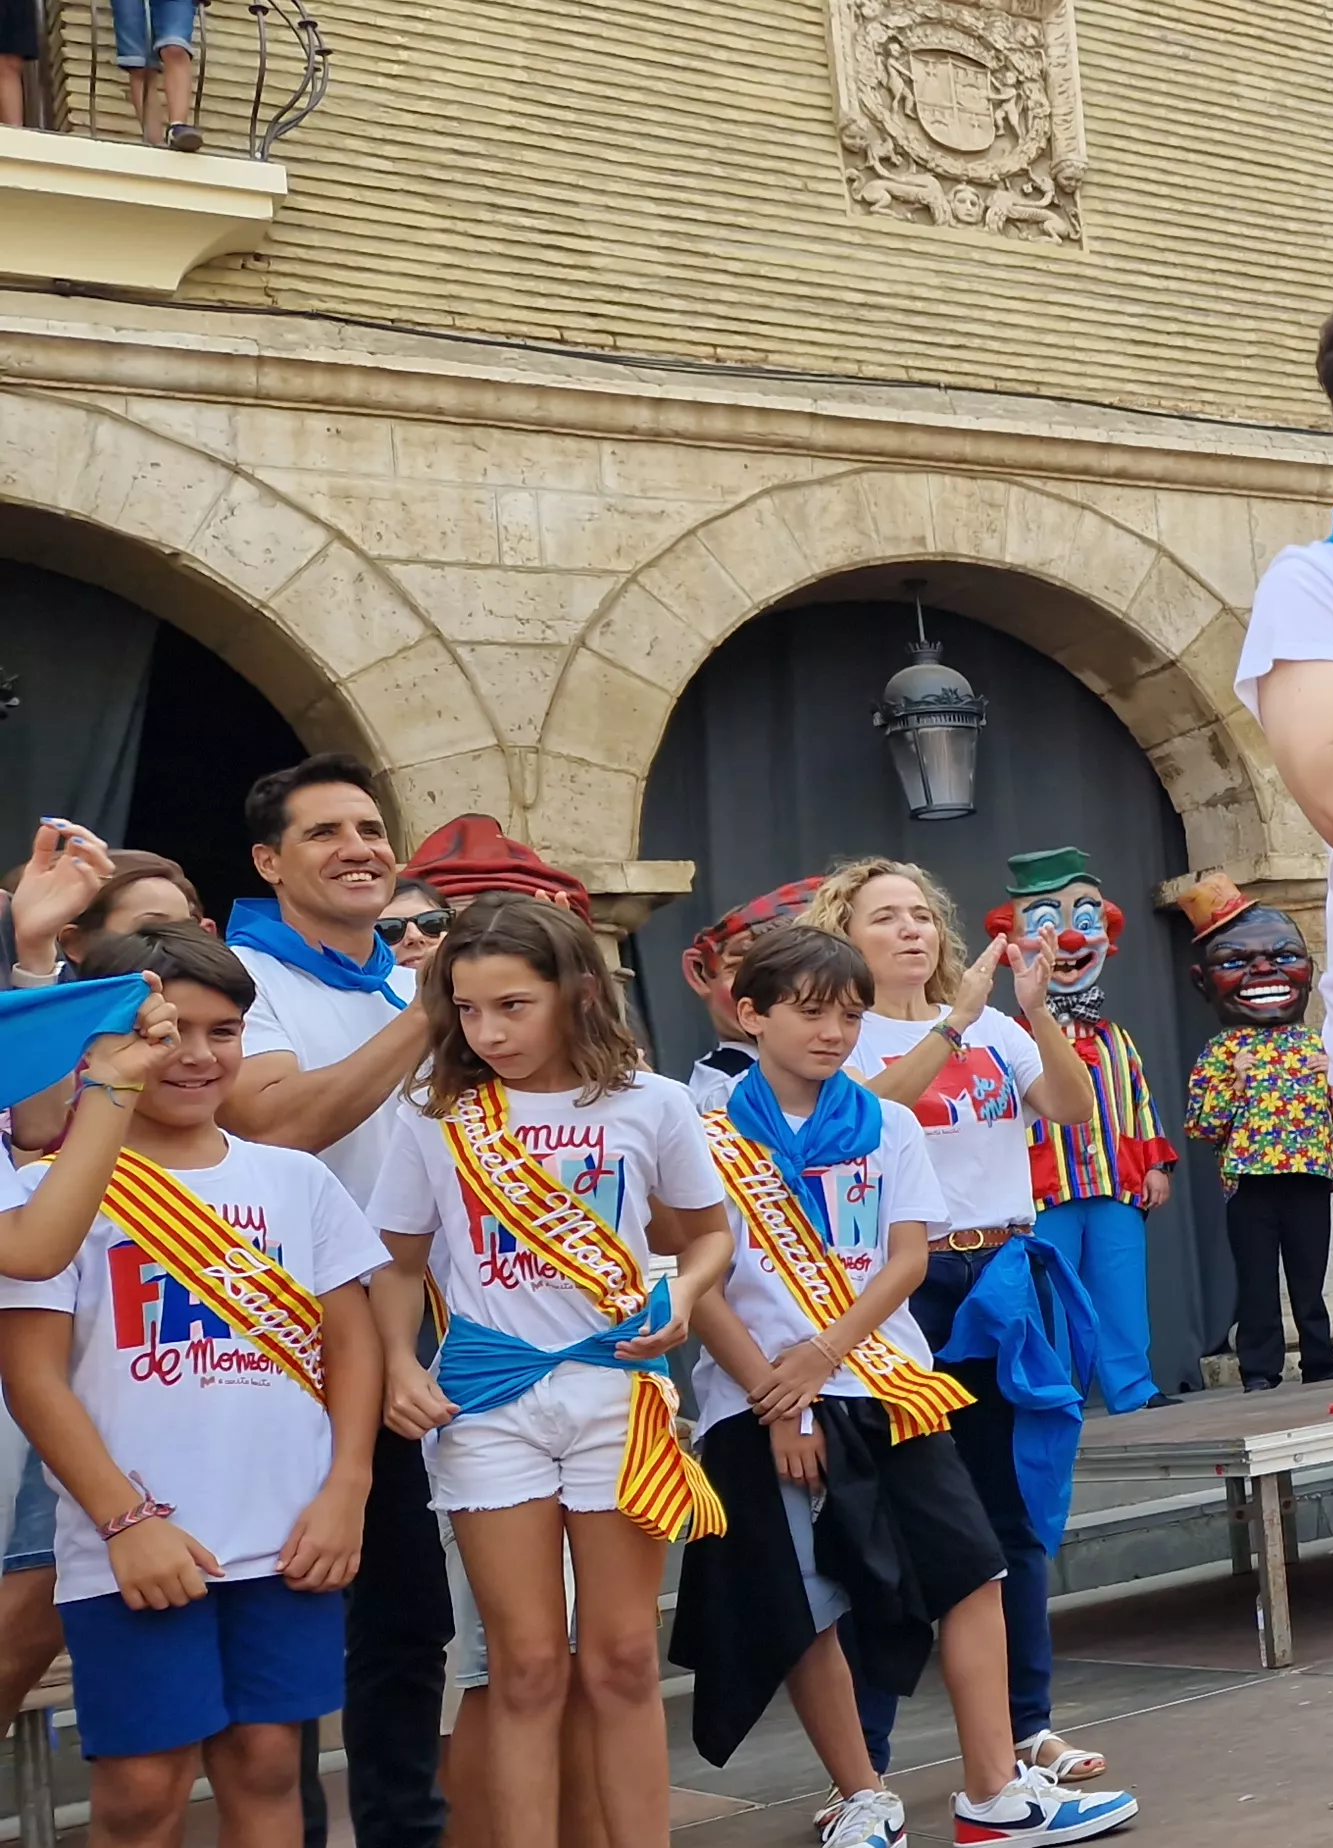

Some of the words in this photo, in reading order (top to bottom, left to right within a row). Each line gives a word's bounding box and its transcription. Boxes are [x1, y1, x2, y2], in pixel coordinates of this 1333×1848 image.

[444, 1088, 531, 1206] agaleta
[514, 1123, 615, 1194] muy
[479, 1231, 520, 1290] de
[739, 1159, 831, 1306] Monzón
[130, 1320, 183, 1387] de
